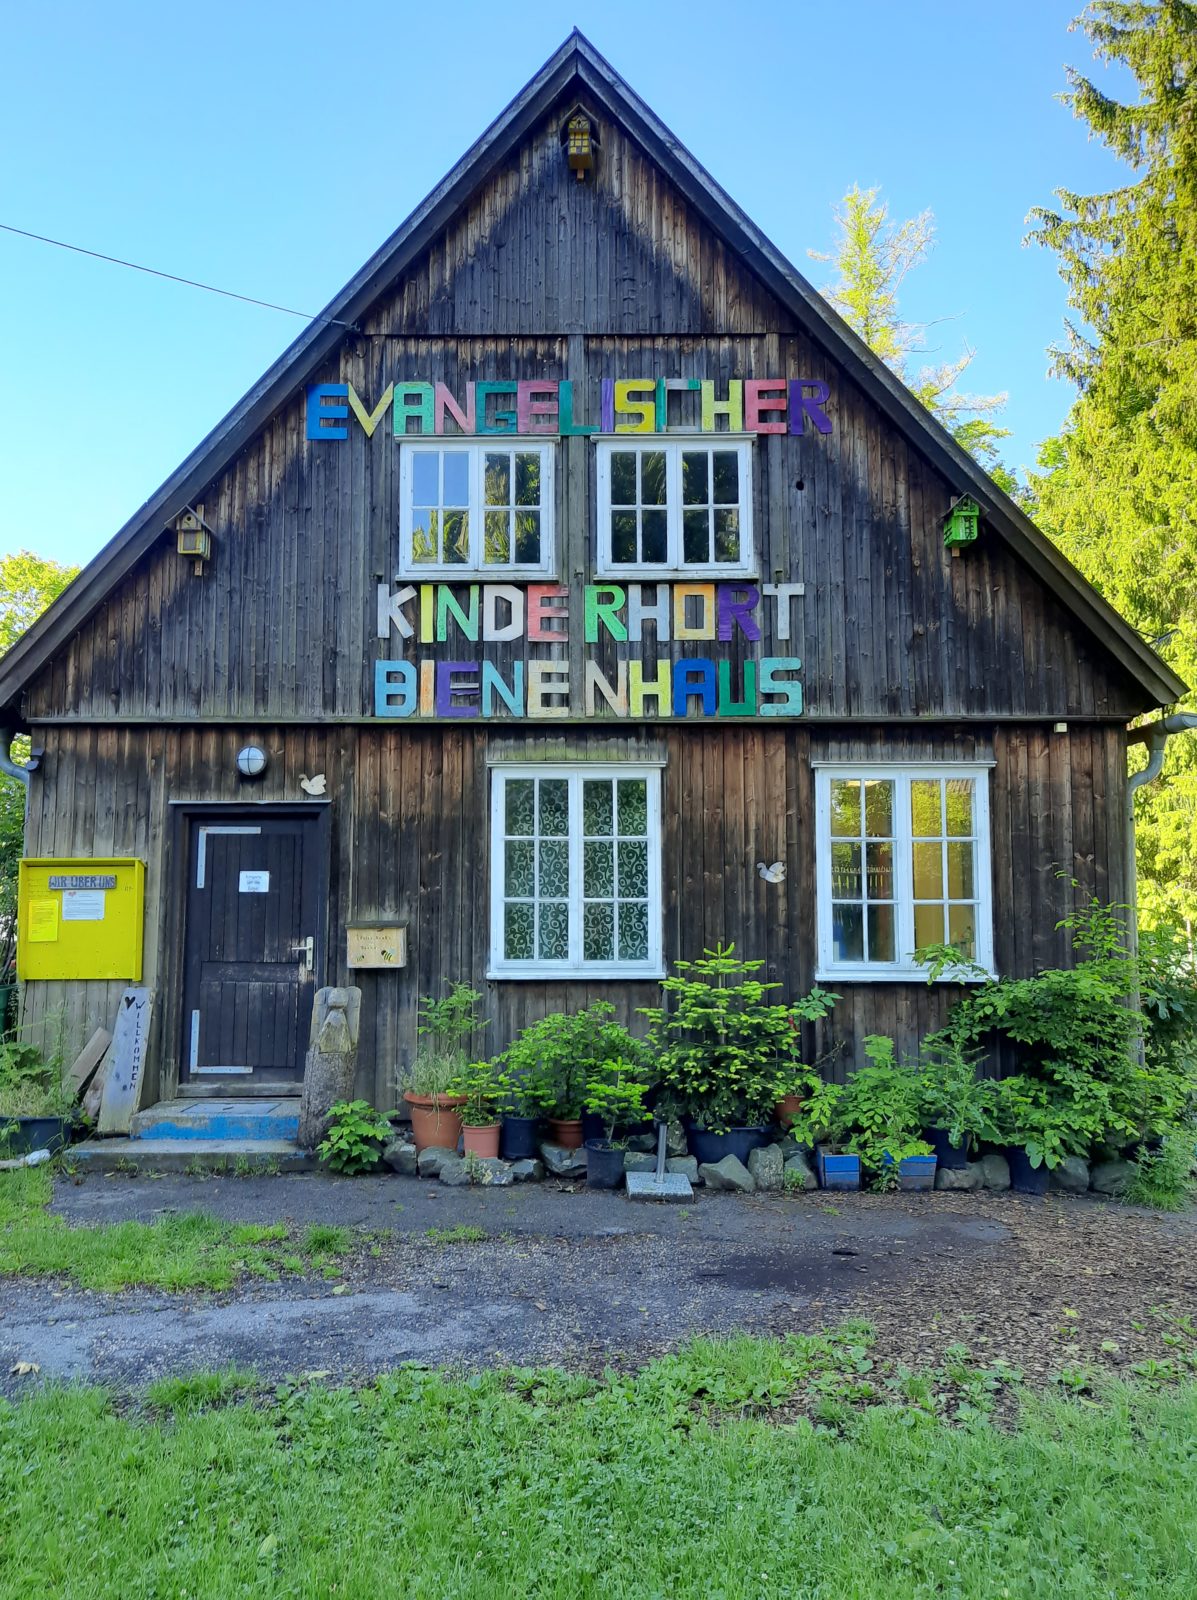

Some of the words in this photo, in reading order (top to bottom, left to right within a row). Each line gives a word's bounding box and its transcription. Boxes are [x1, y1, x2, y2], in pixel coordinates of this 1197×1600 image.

[306, 378, 832, 440] EVANGELISCHER
[374, 657, 803, 718] BIENENHAUS
[129, 1001, 146, 1090] WILLKOMMEN
